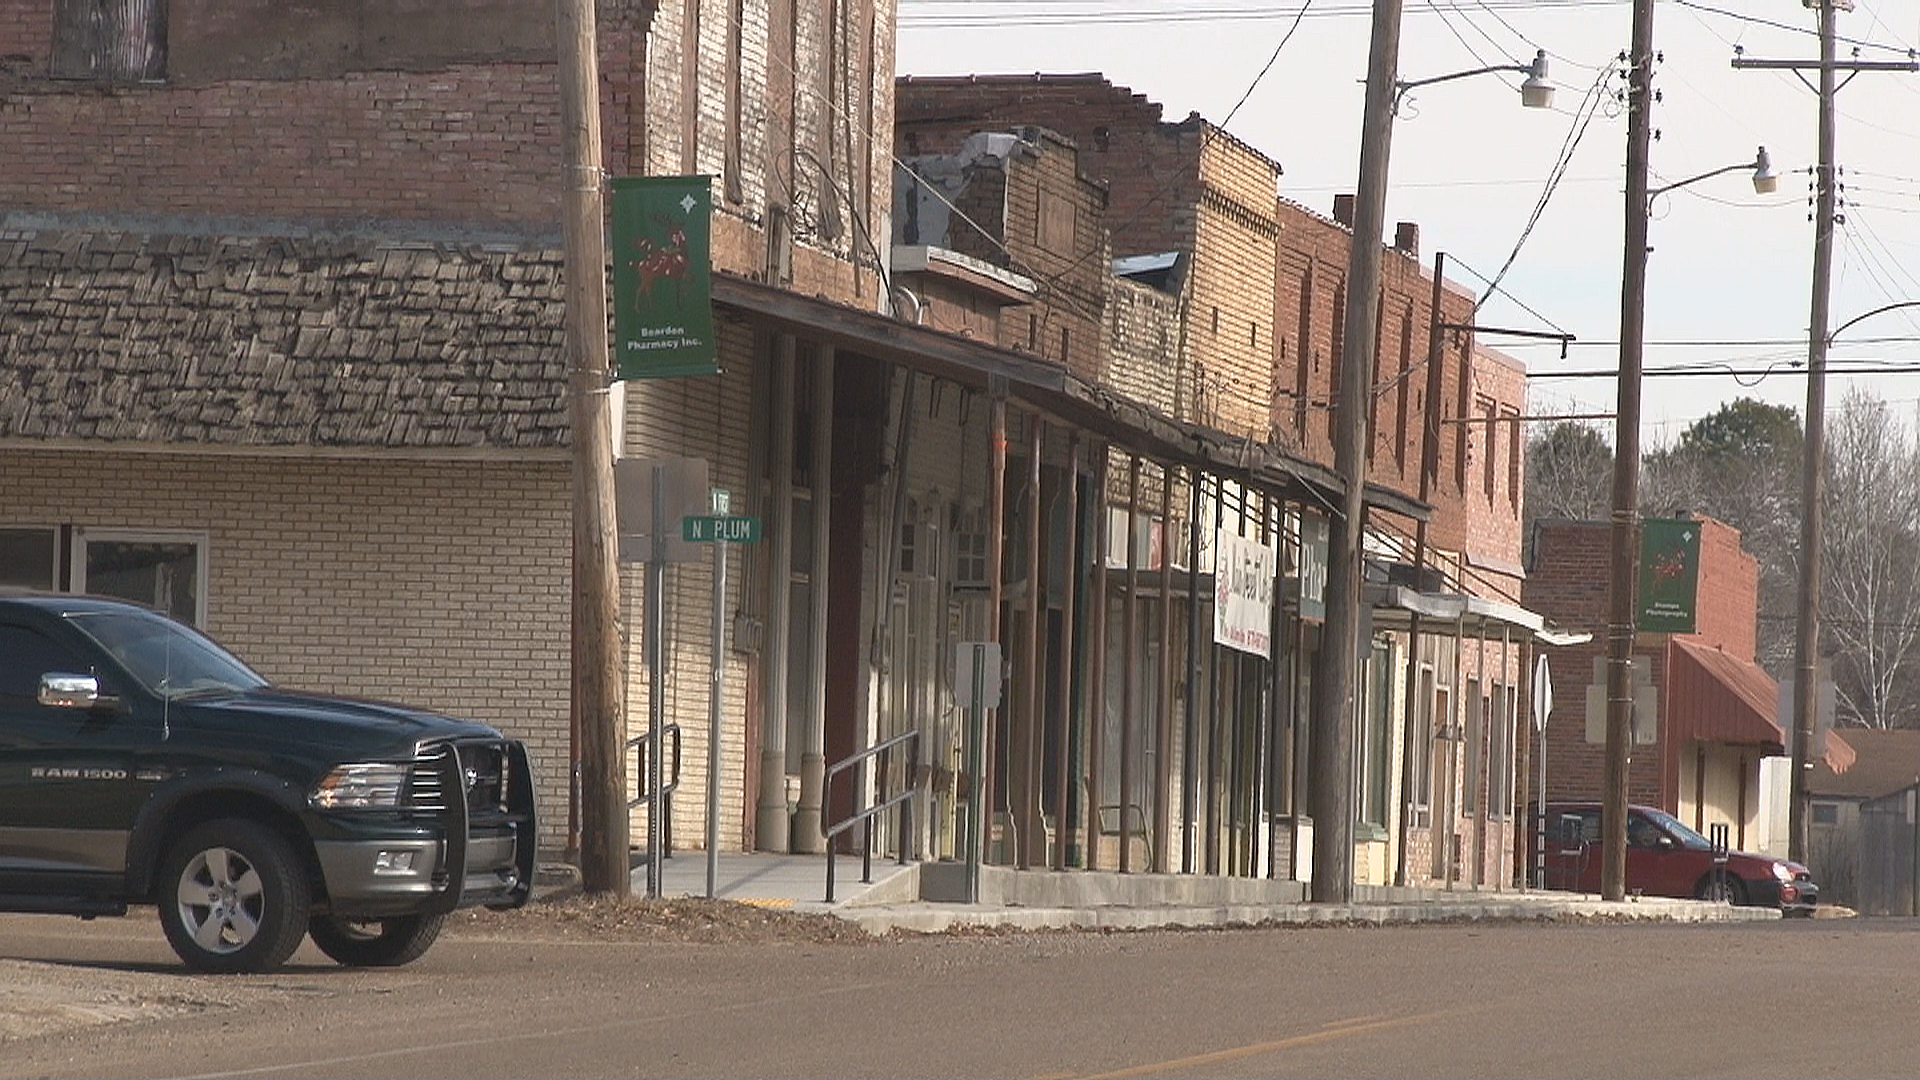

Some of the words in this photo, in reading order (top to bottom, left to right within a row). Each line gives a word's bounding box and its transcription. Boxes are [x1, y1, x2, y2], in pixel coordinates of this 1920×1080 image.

[640, 326, 685, 338] Bearden
[627, 340, 679, 351] Pharmacy
[681, 337, 703, 347] Inc.
[692, 520, 702, 539] N
[714, 520, 751, 540] PLUM
[31, 767, 79, 779] RAM
[83, 768, 128, 780] 1500
